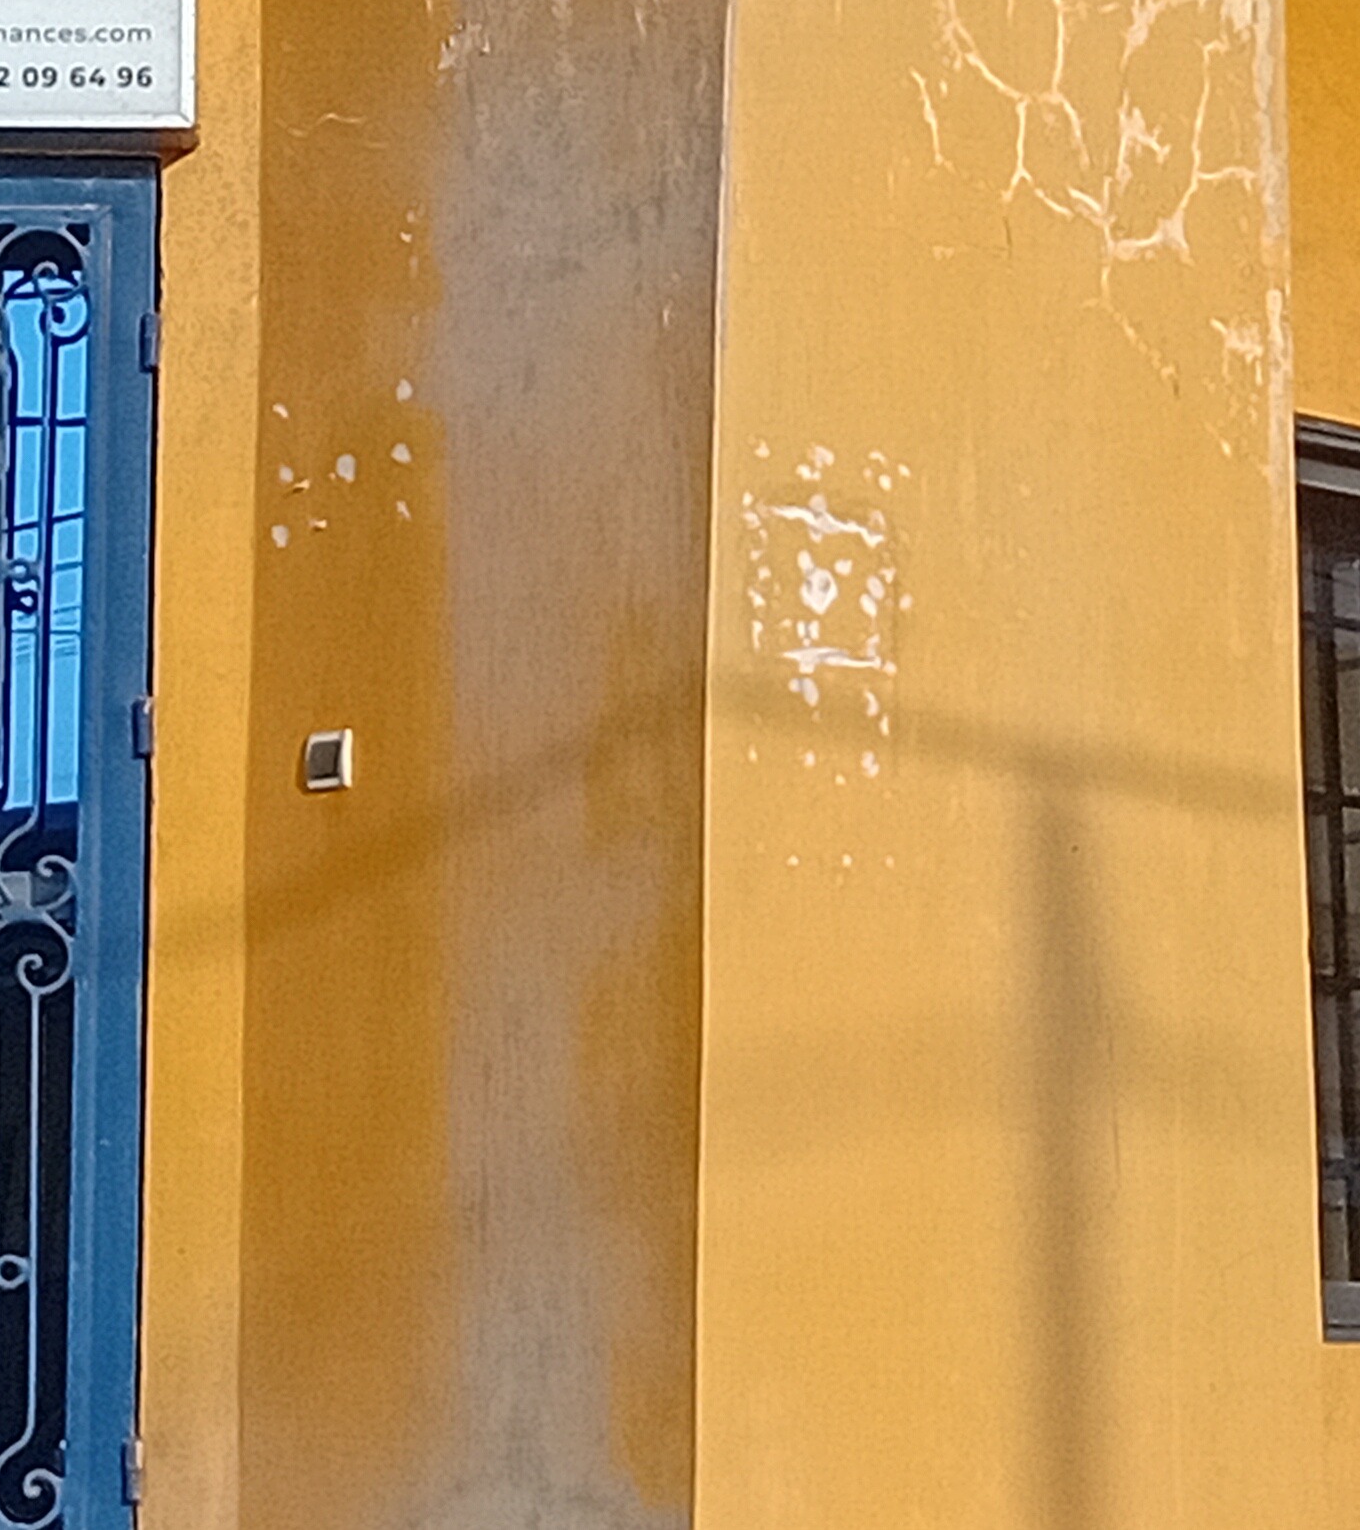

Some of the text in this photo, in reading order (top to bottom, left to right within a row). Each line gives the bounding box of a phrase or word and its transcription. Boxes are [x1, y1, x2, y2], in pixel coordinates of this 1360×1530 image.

[22, 66, 58, 88] 09
[69, 66, 107, 88] 64
[116, 66, 153, 88] 96
